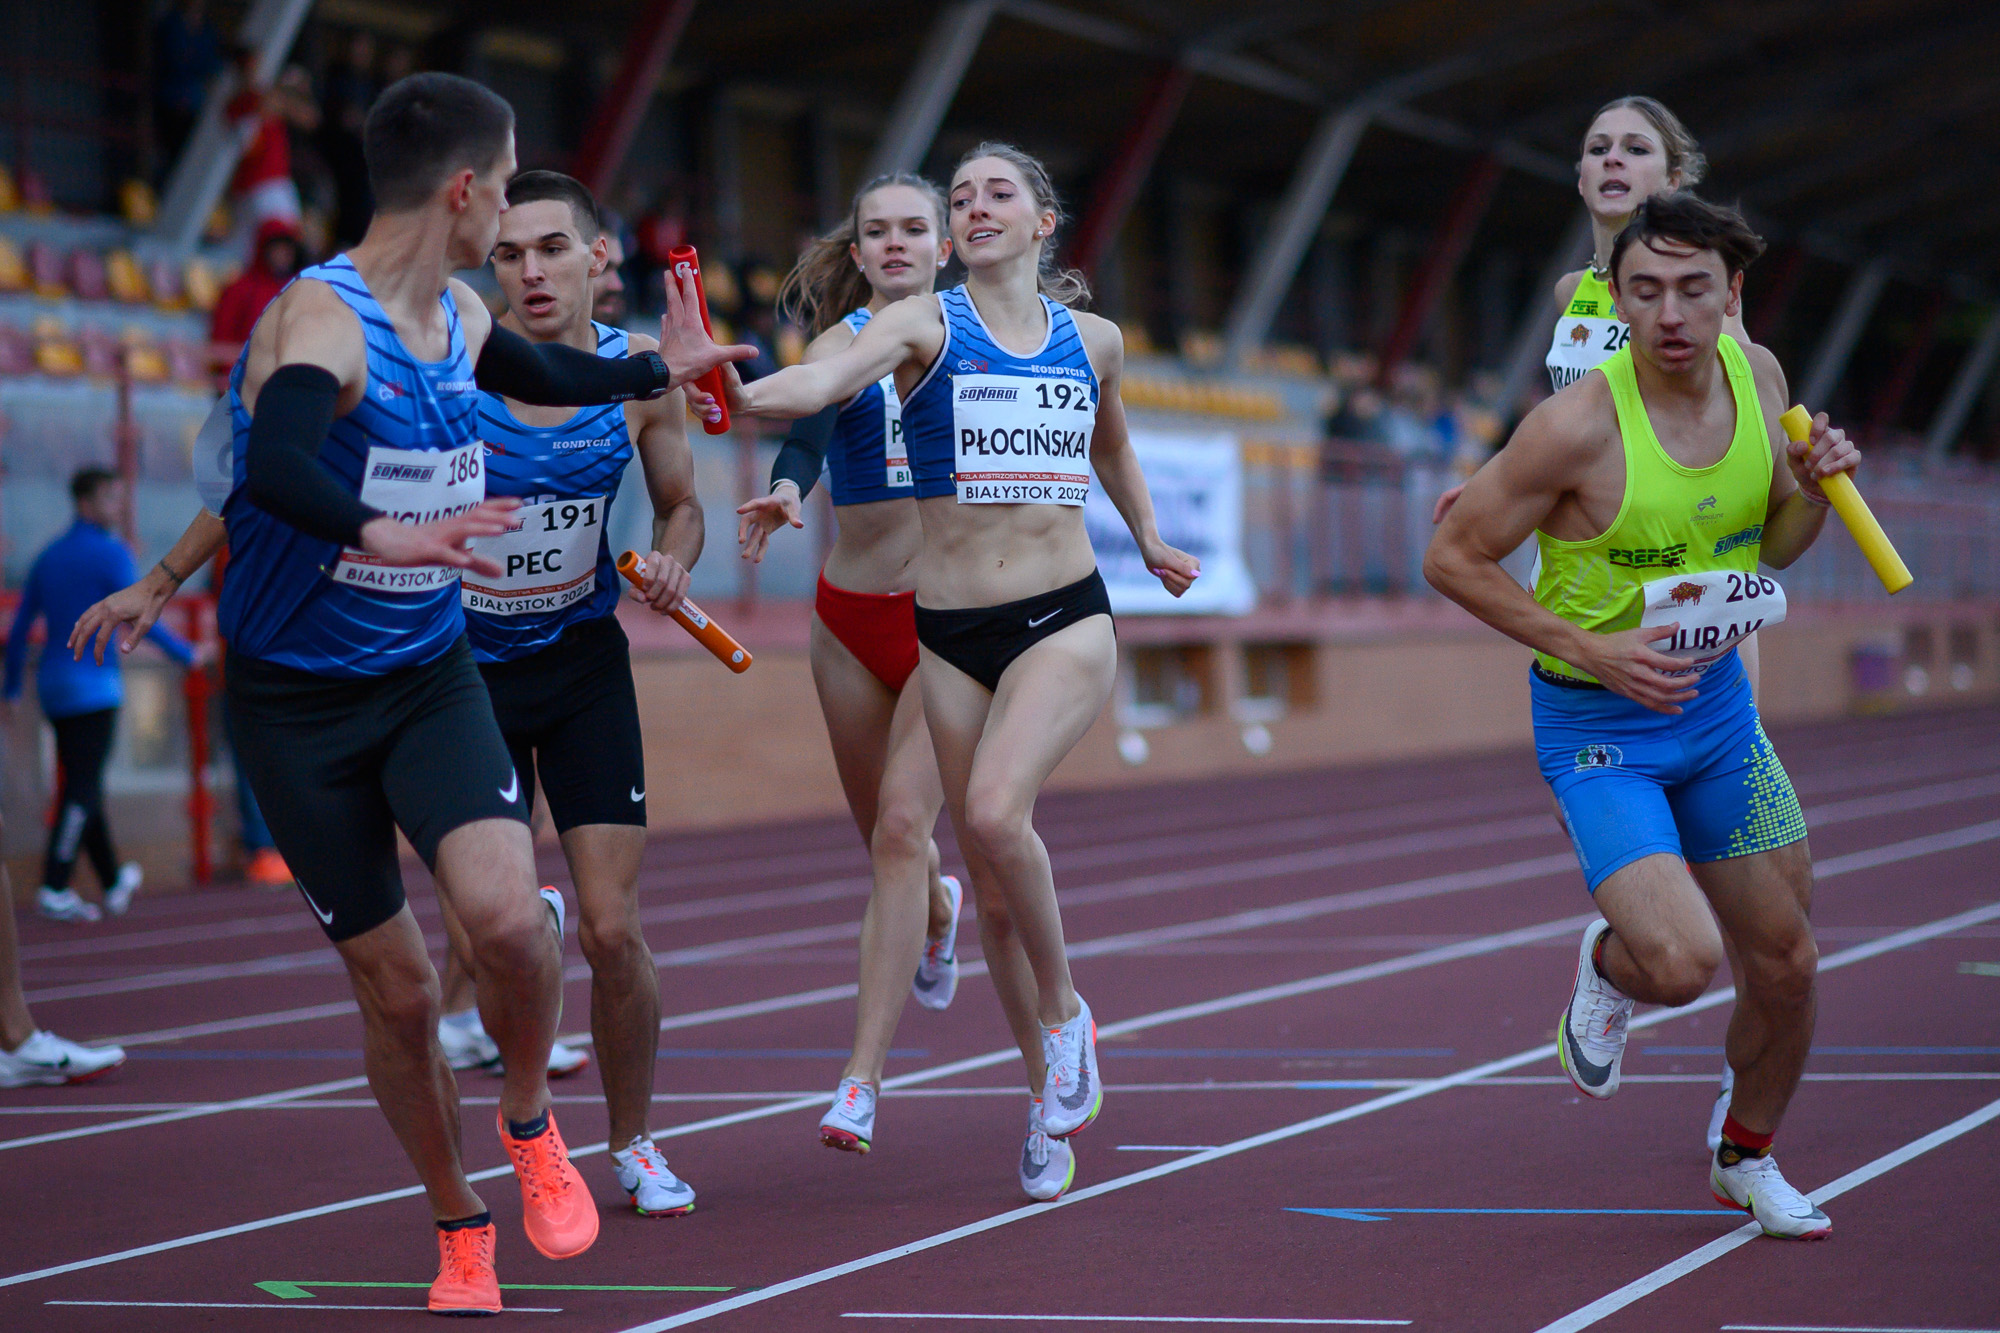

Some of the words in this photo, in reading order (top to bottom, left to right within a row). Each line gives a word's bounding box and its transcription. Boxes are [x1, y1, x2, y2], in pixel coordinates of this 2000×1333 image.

[959, 386, 1019, 402] SONAROL
[1035, 383, 1089, 411] 192
[961, 423, 1087, 459] PŁOCIŃSKA
[447, 448, 479, 487] 186
[966, 486, 1052, 499] BIAŁYSTOK
[541, 503, 598, 532] 191
[507, 549, 562, 577] PEC
[346, 568, 436, 587] BIAŁYSTOK
[1726, 573, 1775, 603] 266
[470, 594, 555, 612] BIAŁYSTOK
[561, 582, 590, 605] 2022
